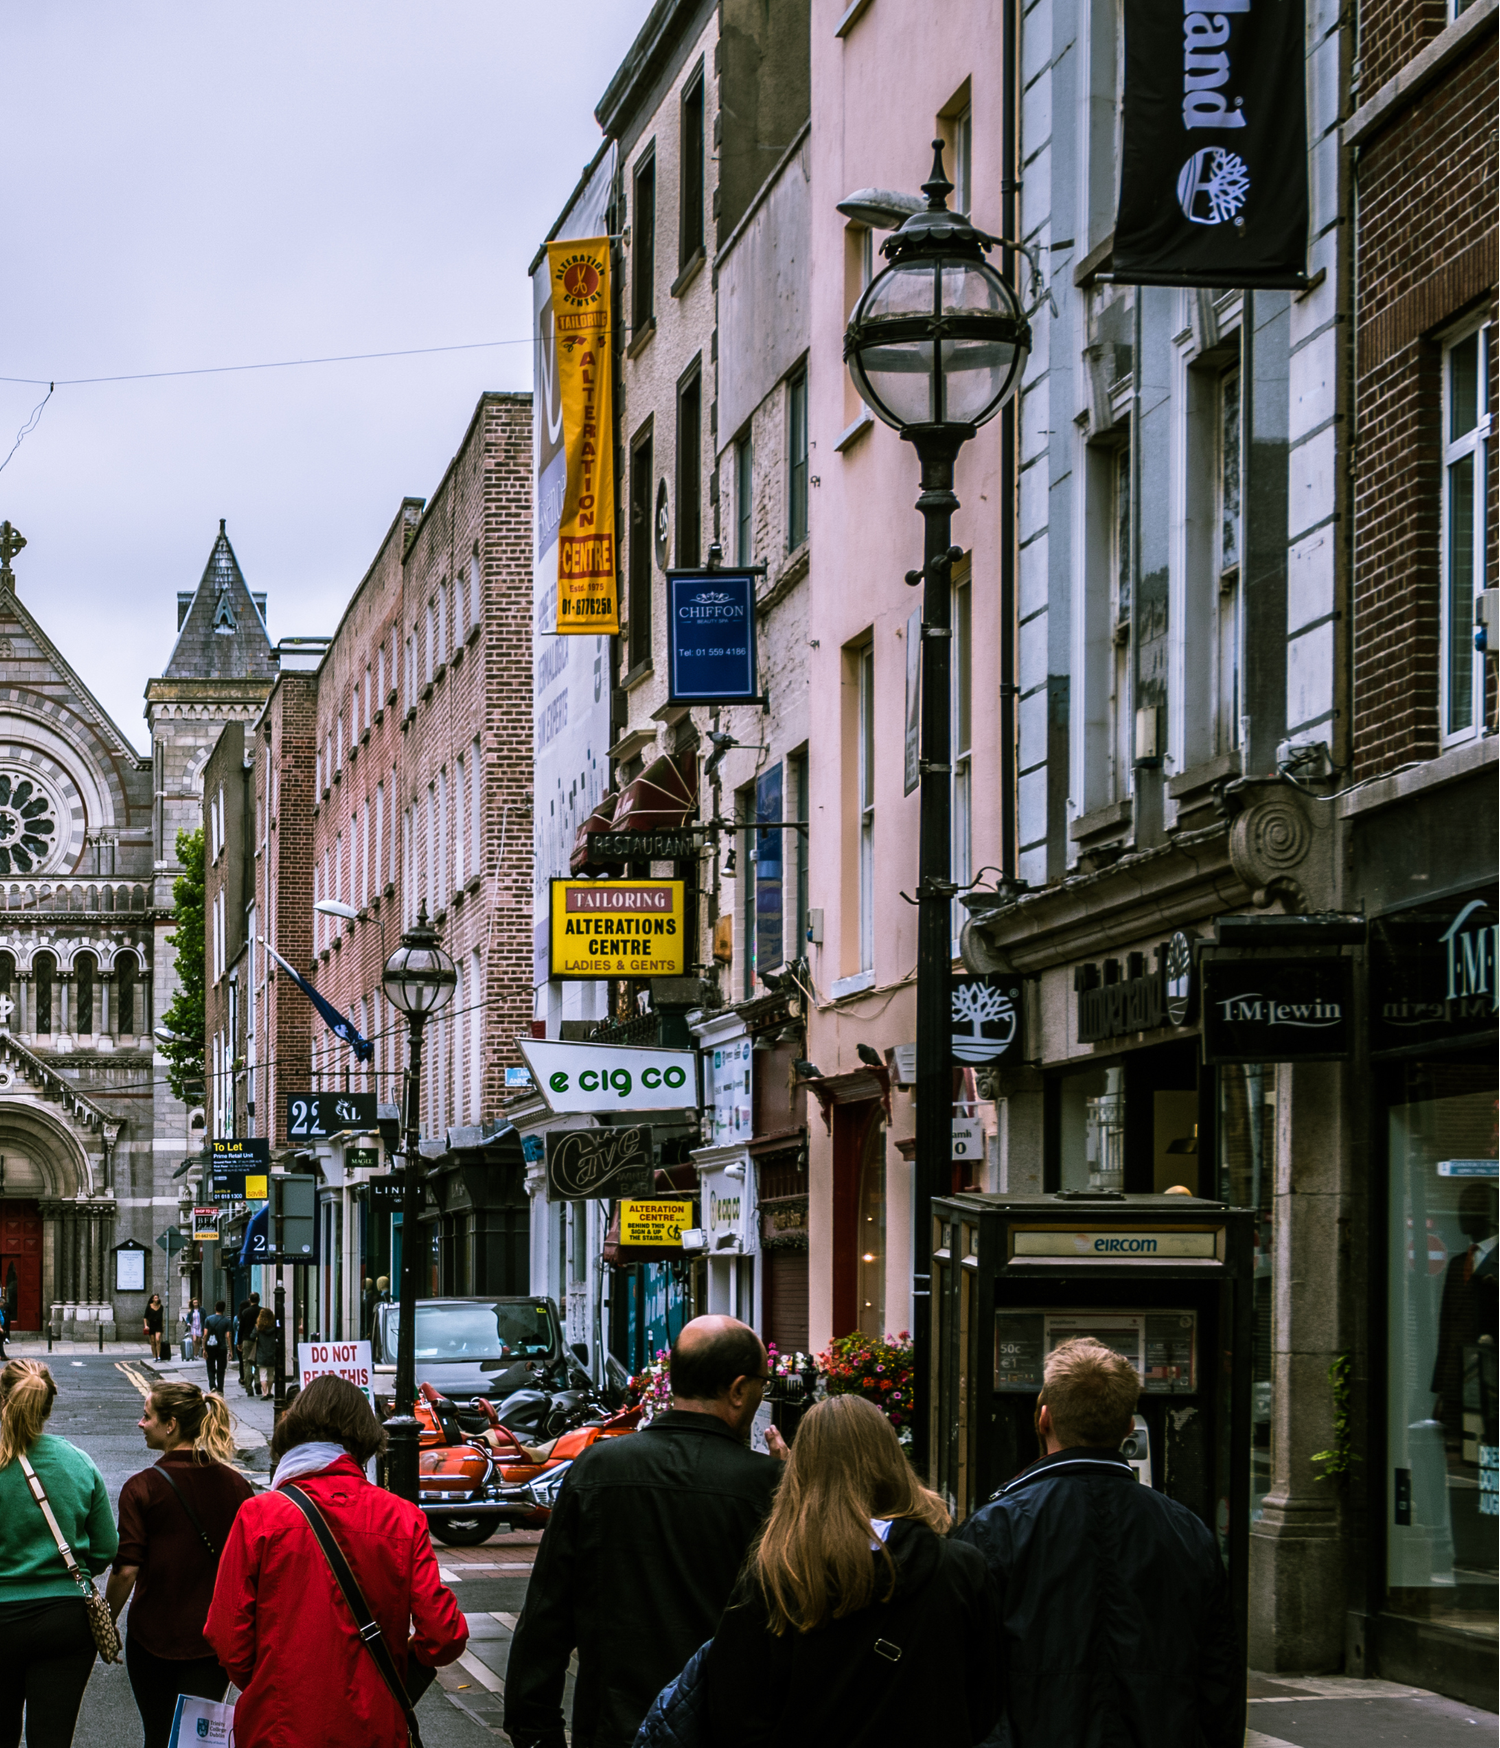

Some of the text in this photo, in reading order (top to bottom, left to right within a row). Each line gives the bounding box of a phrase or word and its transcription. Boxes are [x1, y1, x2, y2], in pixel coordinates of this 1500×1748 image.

[556, 254, 605, 280] ALTERATION
[563, 291, 602, 307] CENTRE
[578, 351, 596, 528] ALTERATION
[563, 541, 611, 574] CENTRE
[588, 583, 604, 592] 1975
[679, 606, 744, 618] CHIFFON
[696, 648, 706, 656] 01
[708, 648, 724, 656] 559
[594, 836, 694, 856] RESTAURANT
[574, 892, 666, 908] TAILORING
[565, 918, 677, 935] ALTERATIONS
[589, 939, 651, 956] CENTRE
[565, 960, 675, 971] LADIES & GENTS
[550, 1072, 569, 1093] e
[641, 1066, 686, 1089] co
[291, 1100, 326, 1134] 22
[213, 1142, 243, 1151] To Let
[629, 1205, 684, 1213] ALTERATION
[253, 1234, 266, 1251] 2
[1094, 1238, 1157, 1252] eircom
[311, 1345, 357, 1363] DO NOT
[304, 1368, 369, 1387] RE THIS
